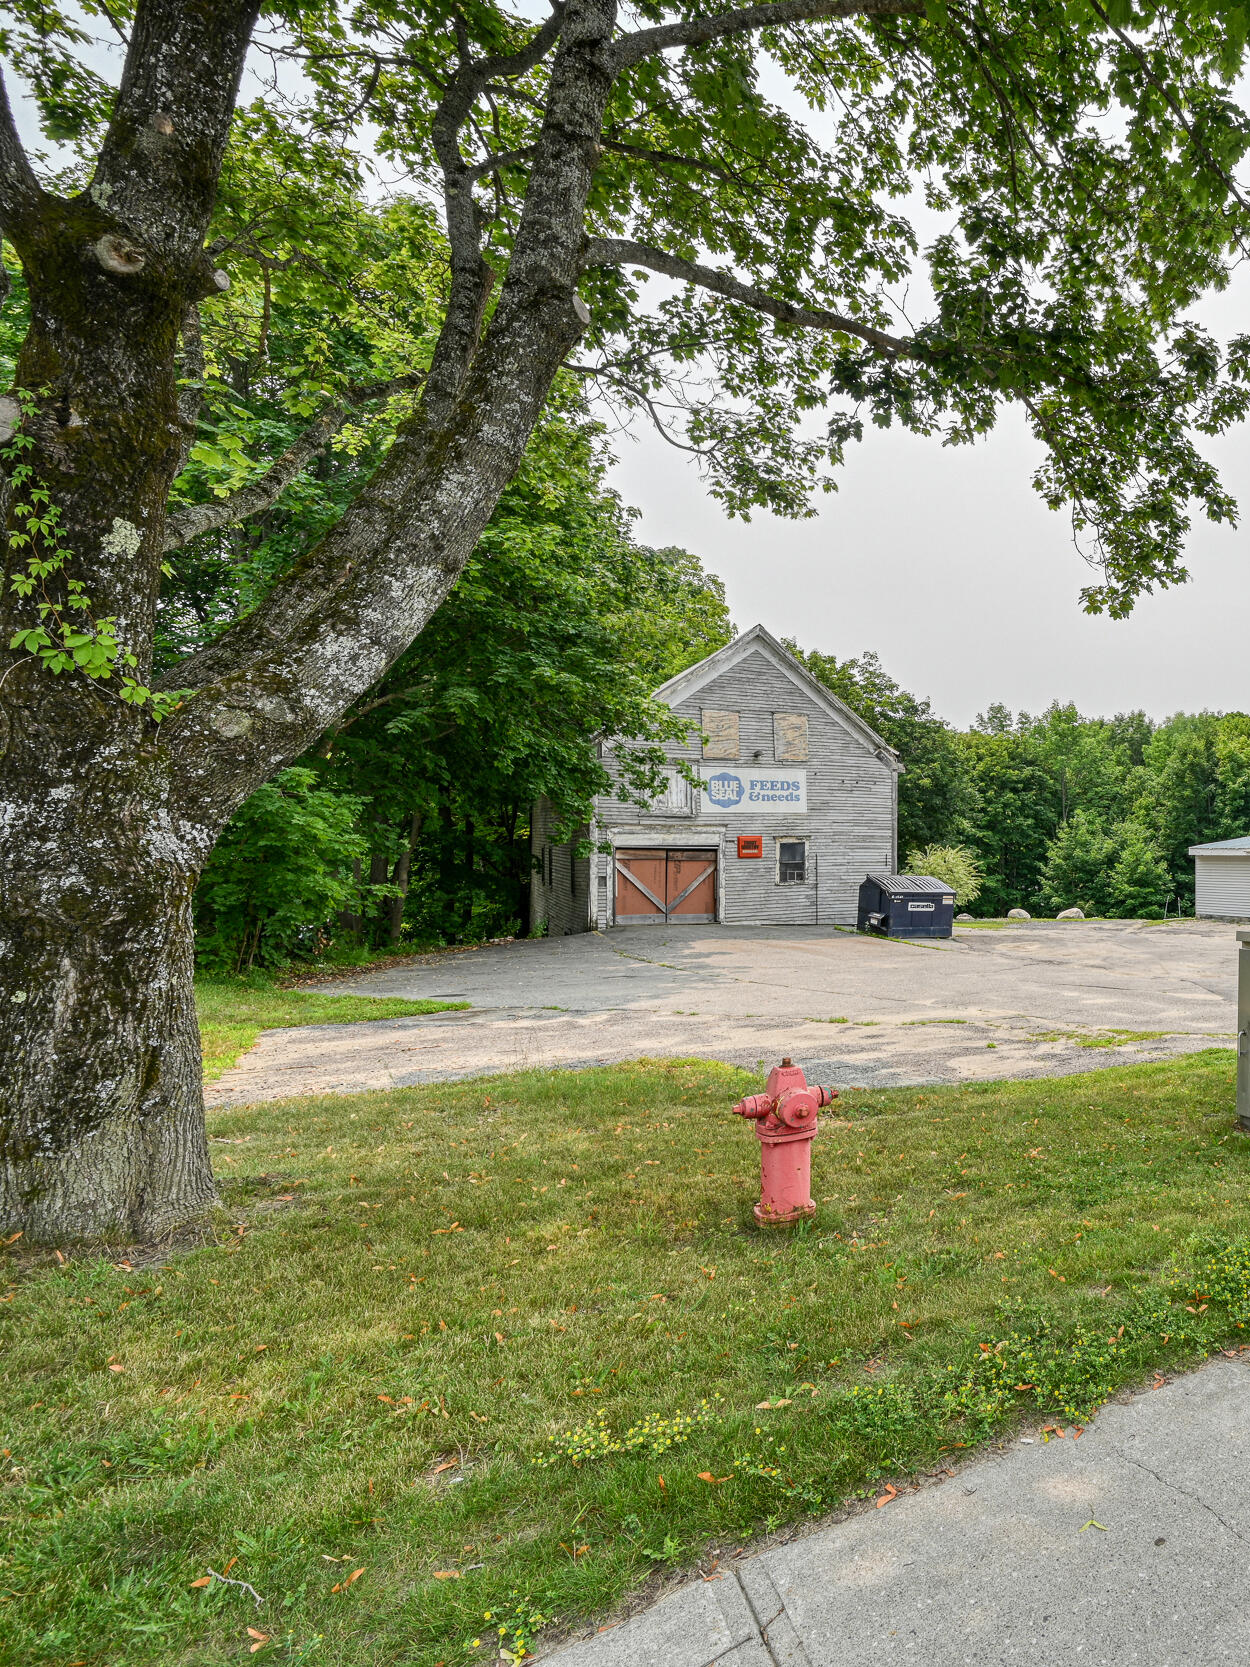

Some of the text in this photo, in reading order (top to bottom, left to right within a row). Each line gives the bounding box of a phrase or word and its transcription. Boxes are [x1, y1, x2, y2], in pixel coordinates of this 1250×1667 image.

[711, 780, 740, 791] BLUE
[749, 780, 800, 791] FEEDS
[711, 790, 740, 801] SEAL
